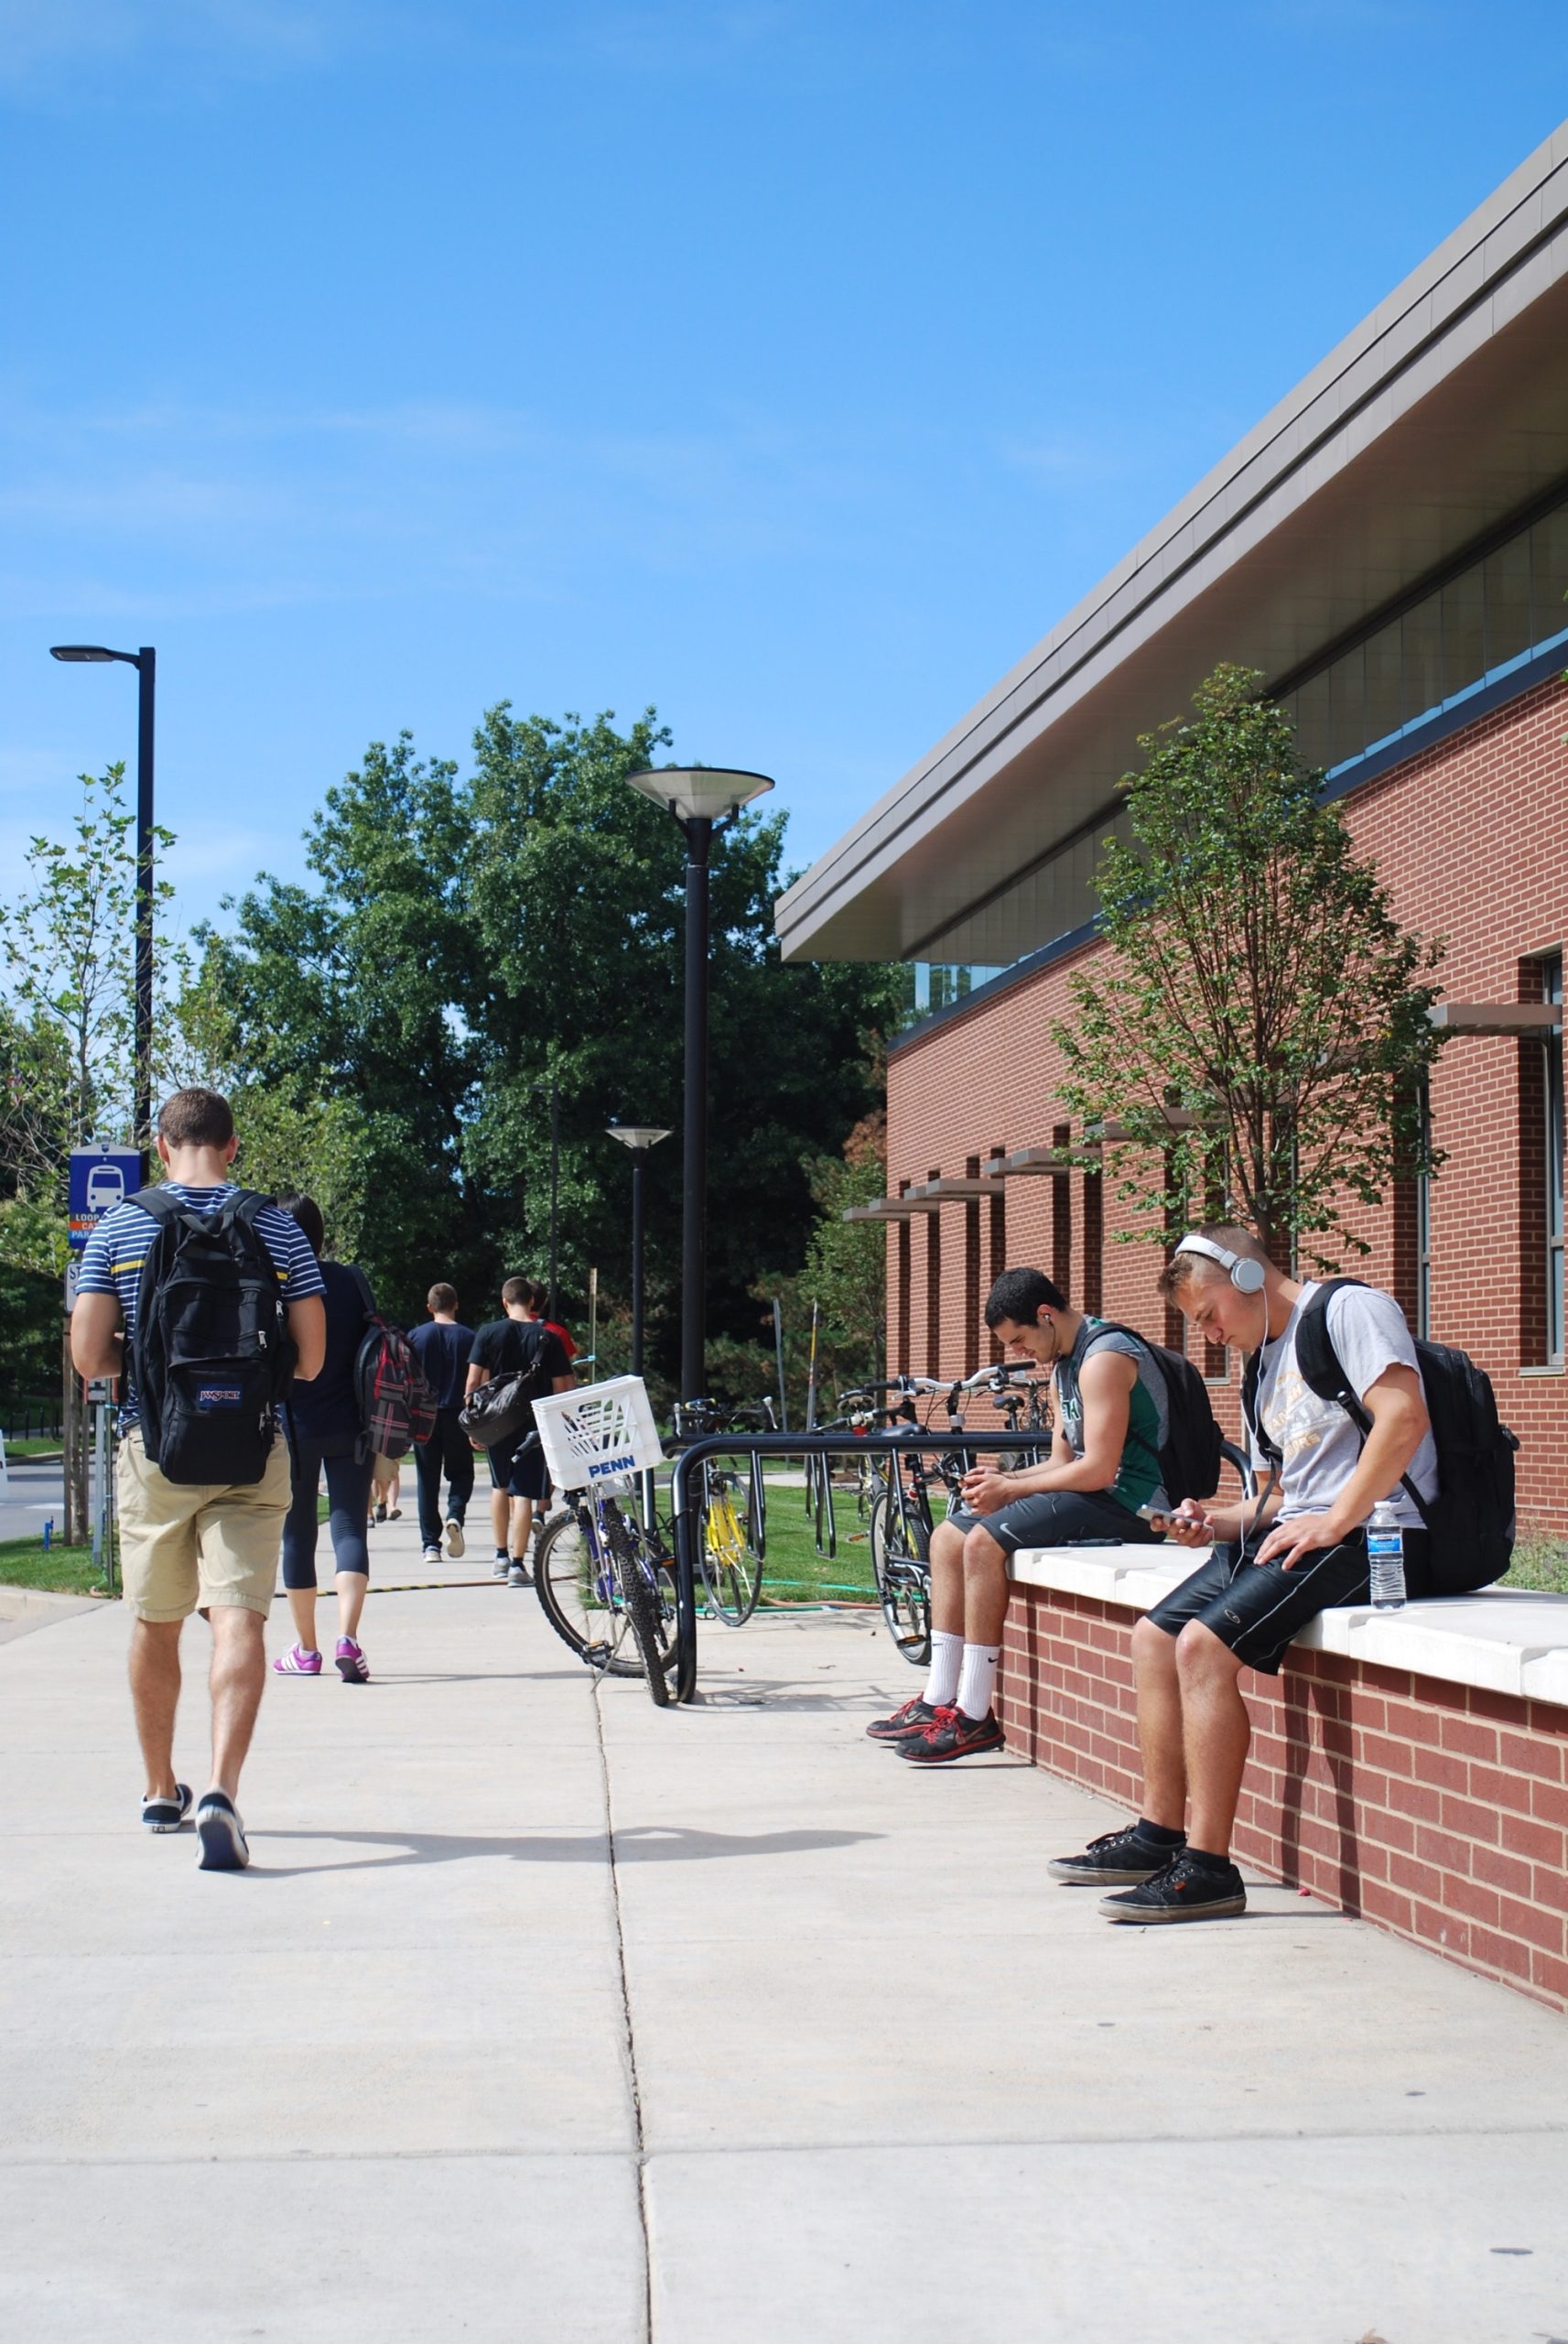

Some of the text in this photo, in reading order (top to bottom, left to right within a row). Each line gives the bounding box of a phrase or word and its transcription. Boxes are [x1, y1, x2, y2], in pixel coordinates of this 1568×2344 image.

[75, 1213, 100, 1221] LOOP
[200, 1390, 241, 1402] JANSPORT
[588, 1455, 635, 1479] PENN
